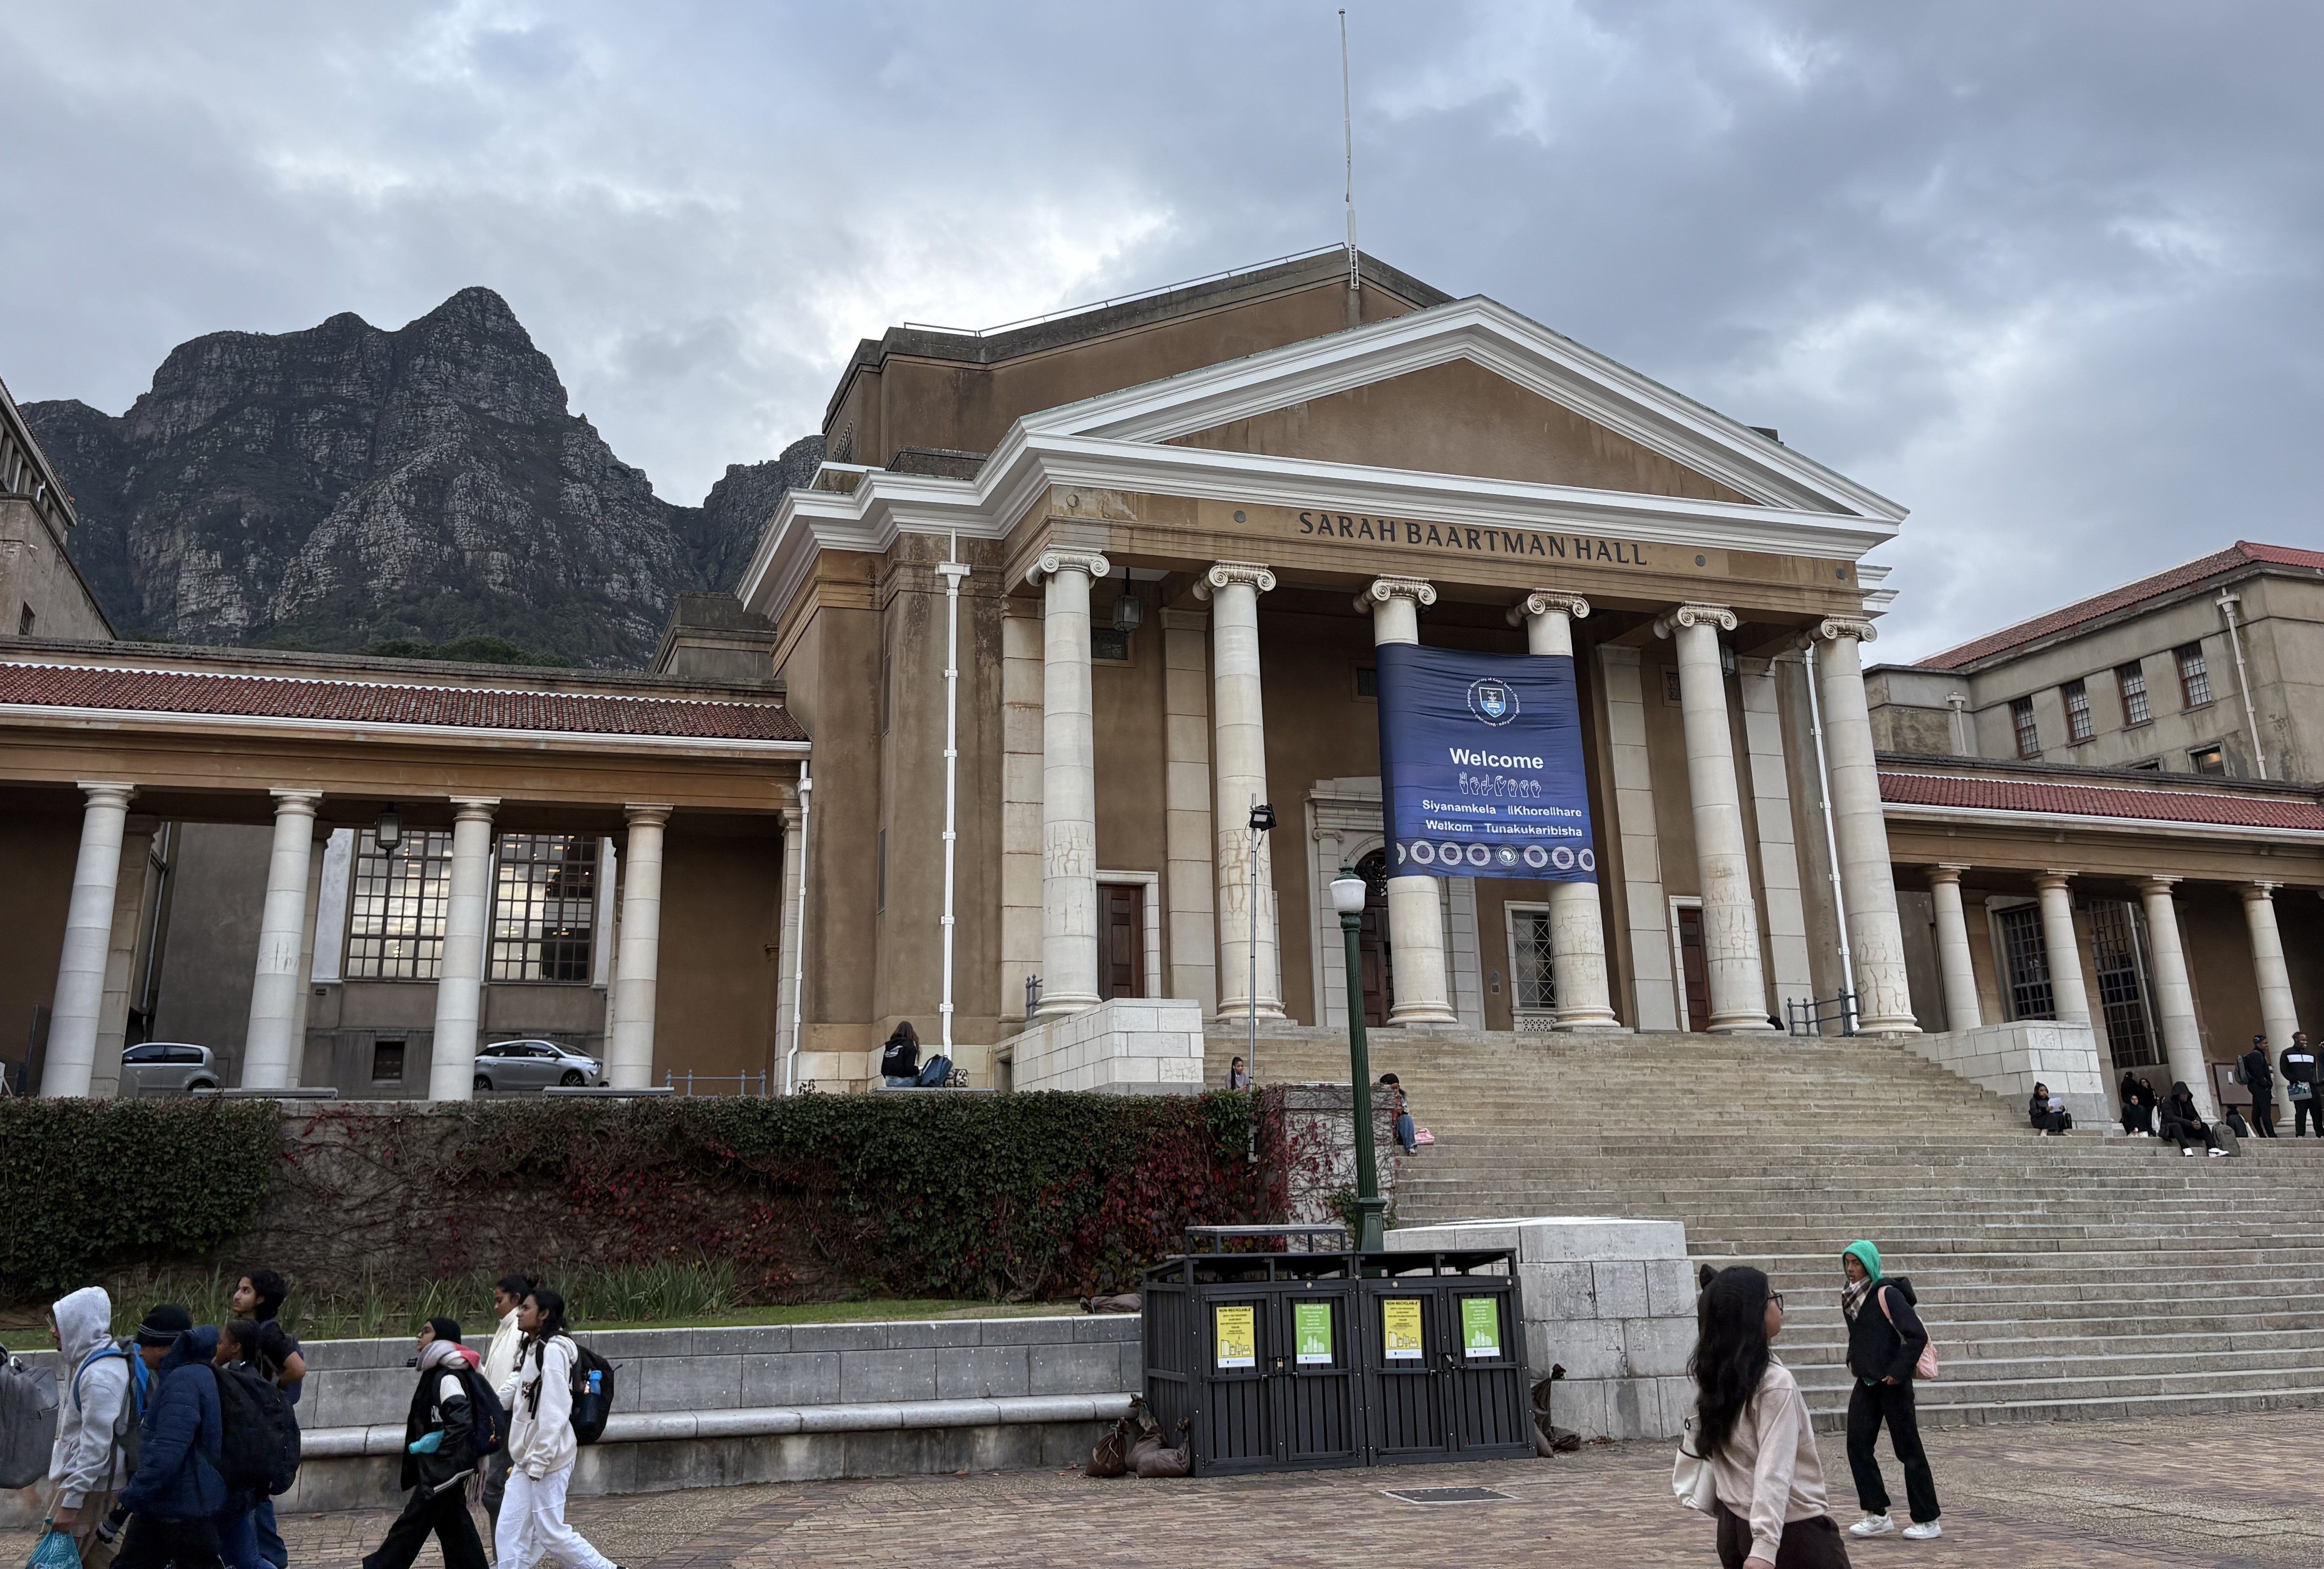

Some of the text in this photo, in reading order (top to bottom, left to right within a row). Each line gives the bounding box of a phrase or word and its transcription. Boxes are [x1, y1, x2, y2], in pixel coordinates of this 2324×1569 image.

[1299, 512, 1647, 565] SARAH BAARTMAN HALL
[1449, 748, 1544, 769] Welcome
[1422, 799, 1496, 815] Siyanamkela
[1425, 819, 1582, 837] Welkom Tunakukaribisha
